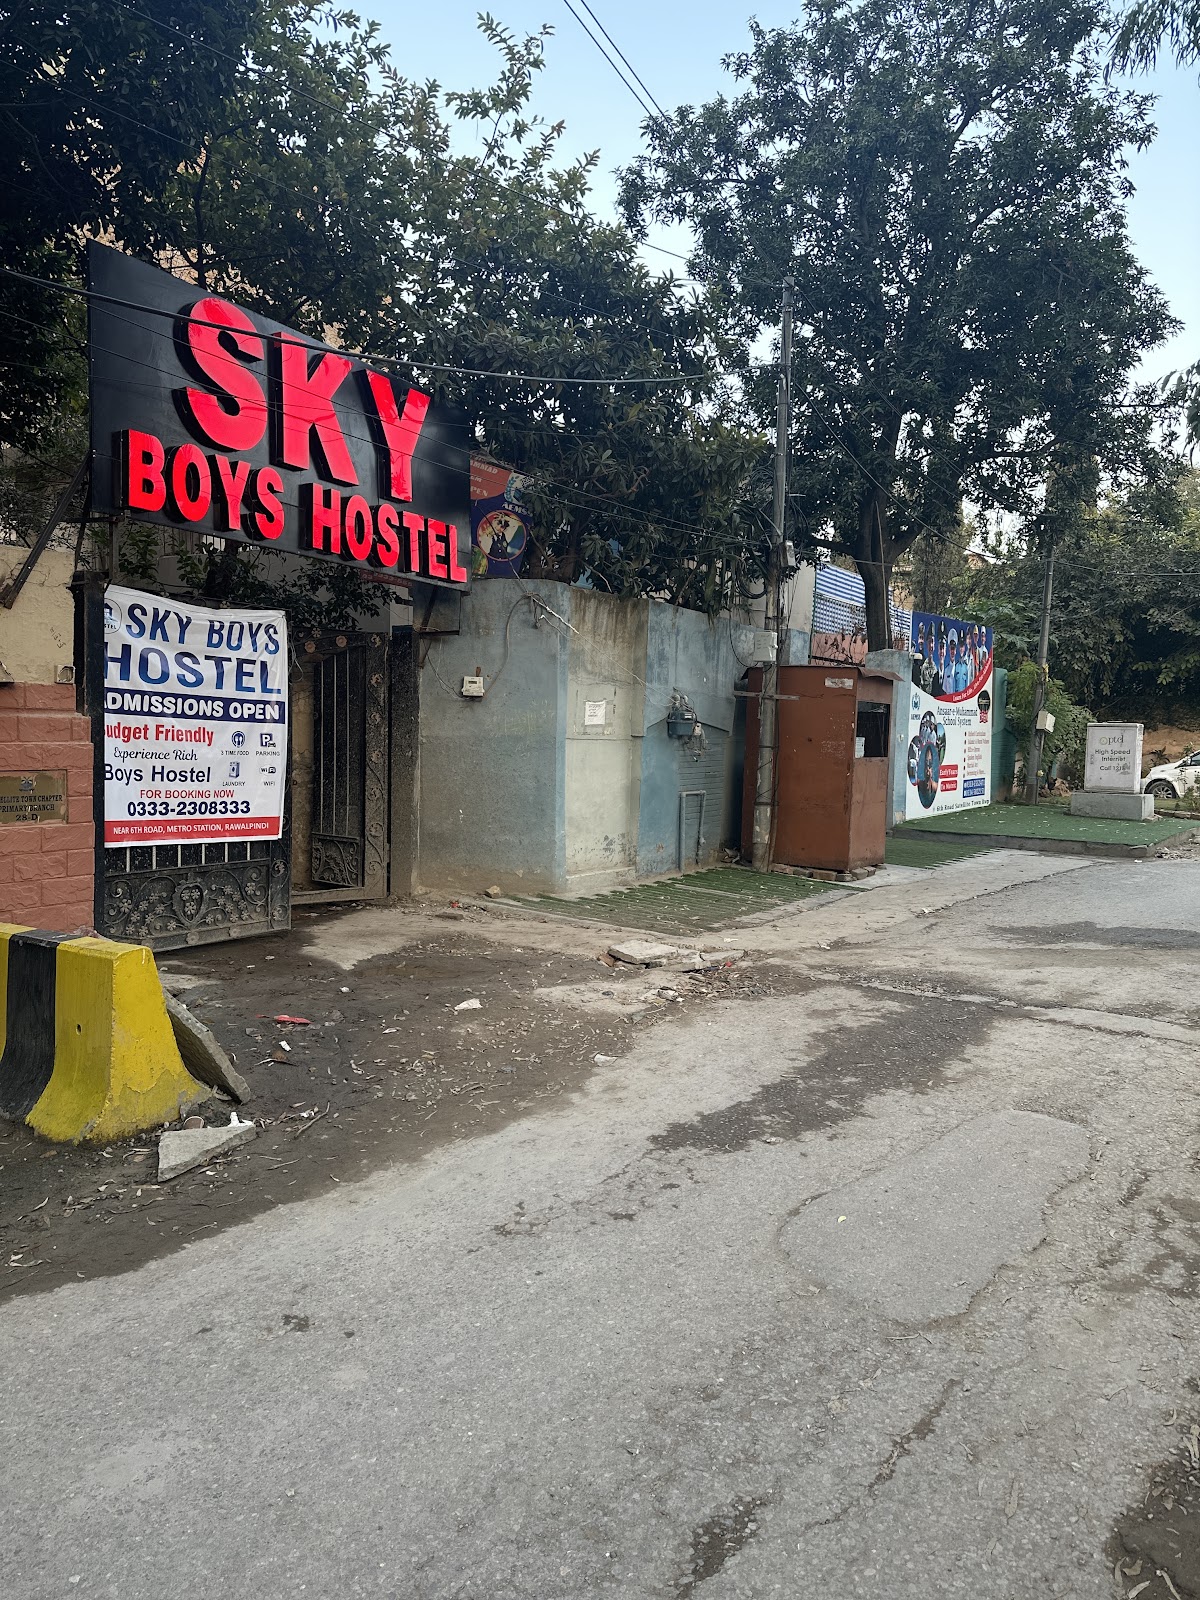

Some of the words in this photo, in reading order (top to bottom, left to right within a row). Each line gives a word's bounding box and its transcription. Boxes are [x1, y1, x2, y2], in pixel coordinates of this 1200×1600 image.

[183, 297, 431, 502] SKY
[125, 428, 285, 540] BOYS
[309, 482, 468, 583] HOSTEL
[125, 603, 193, 645] SKY
[206, 619, 280, 655] BOYS
[104, 641, 282, 695] HOSTEL
[104, 691, 224, 716] DMISSIONS
[228, 702, 280, 720] OPEN
[104, 722, 149, 744] udget
[155, 724, 214, 747] Friendly
[113, 747, 170, 762] Experience
[172, 748, 198, 761] Rich
[104, 763, 144, 786] Boys
[151, 765, 212, 783] Hostel
[0, 795, 20, 804] ELLITE
[20, 795, 37, 803] TOWN
[37, 794, 63, 802] CHAPTER
[140, 789, 162, 798] FOR
[165, 789, 211, 798] BOOKING
[213, 789, 235, 798] NOW
[29, 803, 55, 812] BRANCH
[127, 800, 251, 817] 0333-2308333
[113, 827, 130, 835] NEAR
[143, 826, 165, 834] ROAD,
[166, 825, 192, 833] METRO
[193, 824, 223, 833] STATION,
[224, 822, 269, 831] RAWALPINDI
